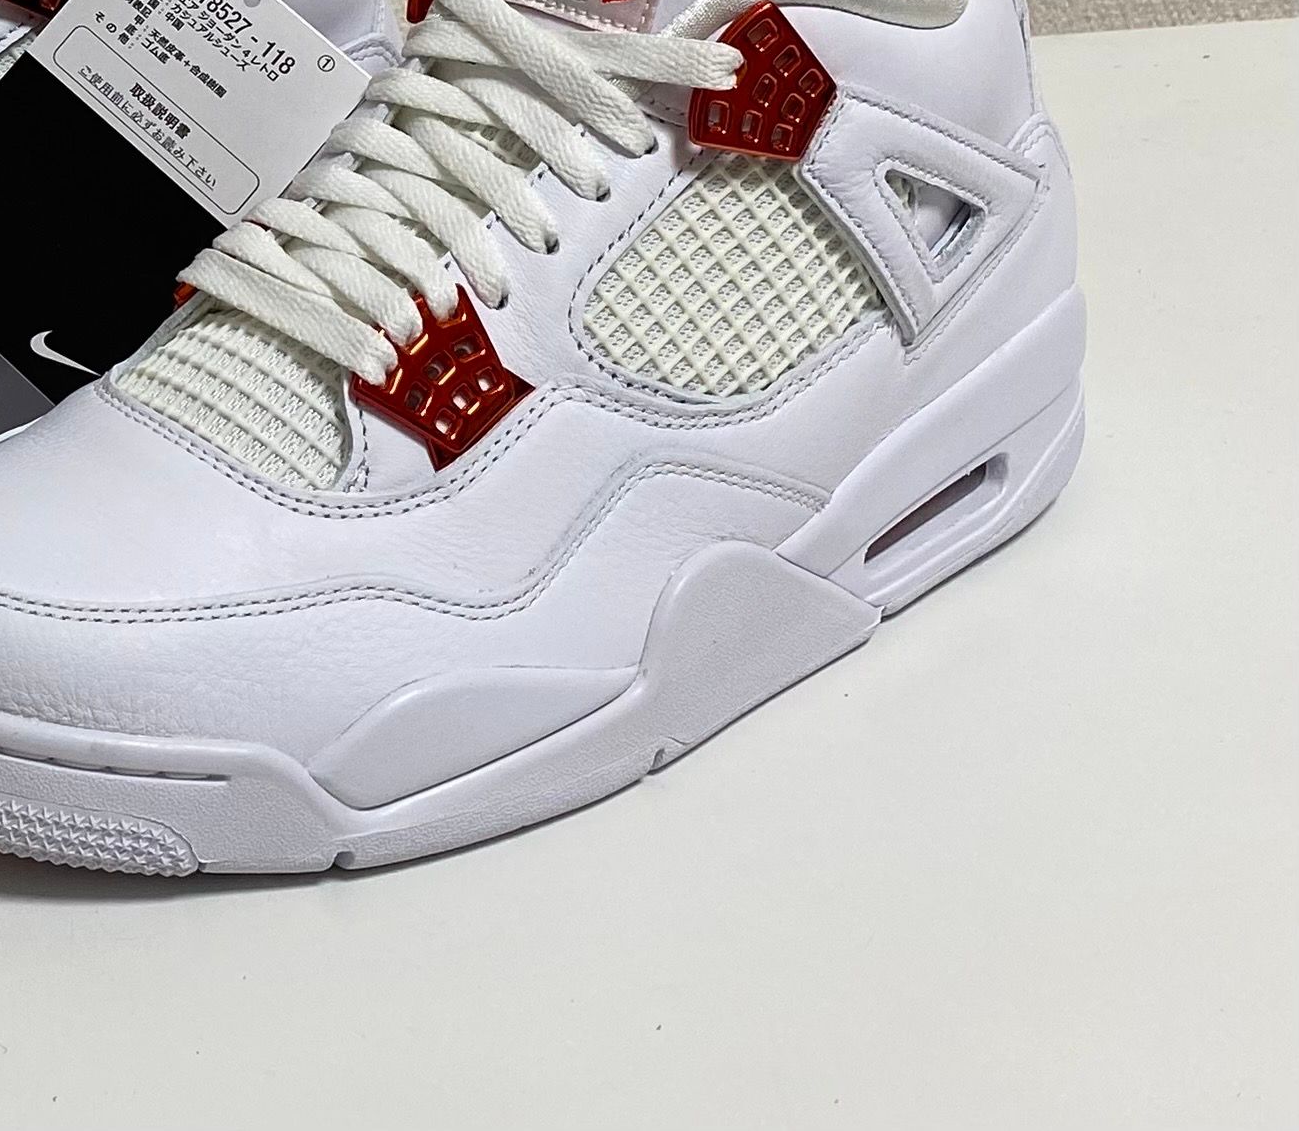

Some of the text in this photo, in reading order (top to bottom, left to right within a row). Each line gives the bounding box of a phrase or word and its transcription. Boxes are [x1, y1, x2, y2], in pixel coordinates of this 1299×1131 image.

[164, 11, 185, 32] 中国
[170, 2, 251, 72] カジュアルシューズ
[197, 10, 242, 49] ジョーダン
[242, 49, 252, 58] 4
[250, 54, 280, 82] レトロ
[261, 41, 296, 75] 118
[77, 64, 217, 189] ご使用前に必ずお読み下さい
[128, 81, 191, 140] 取扱説明書
